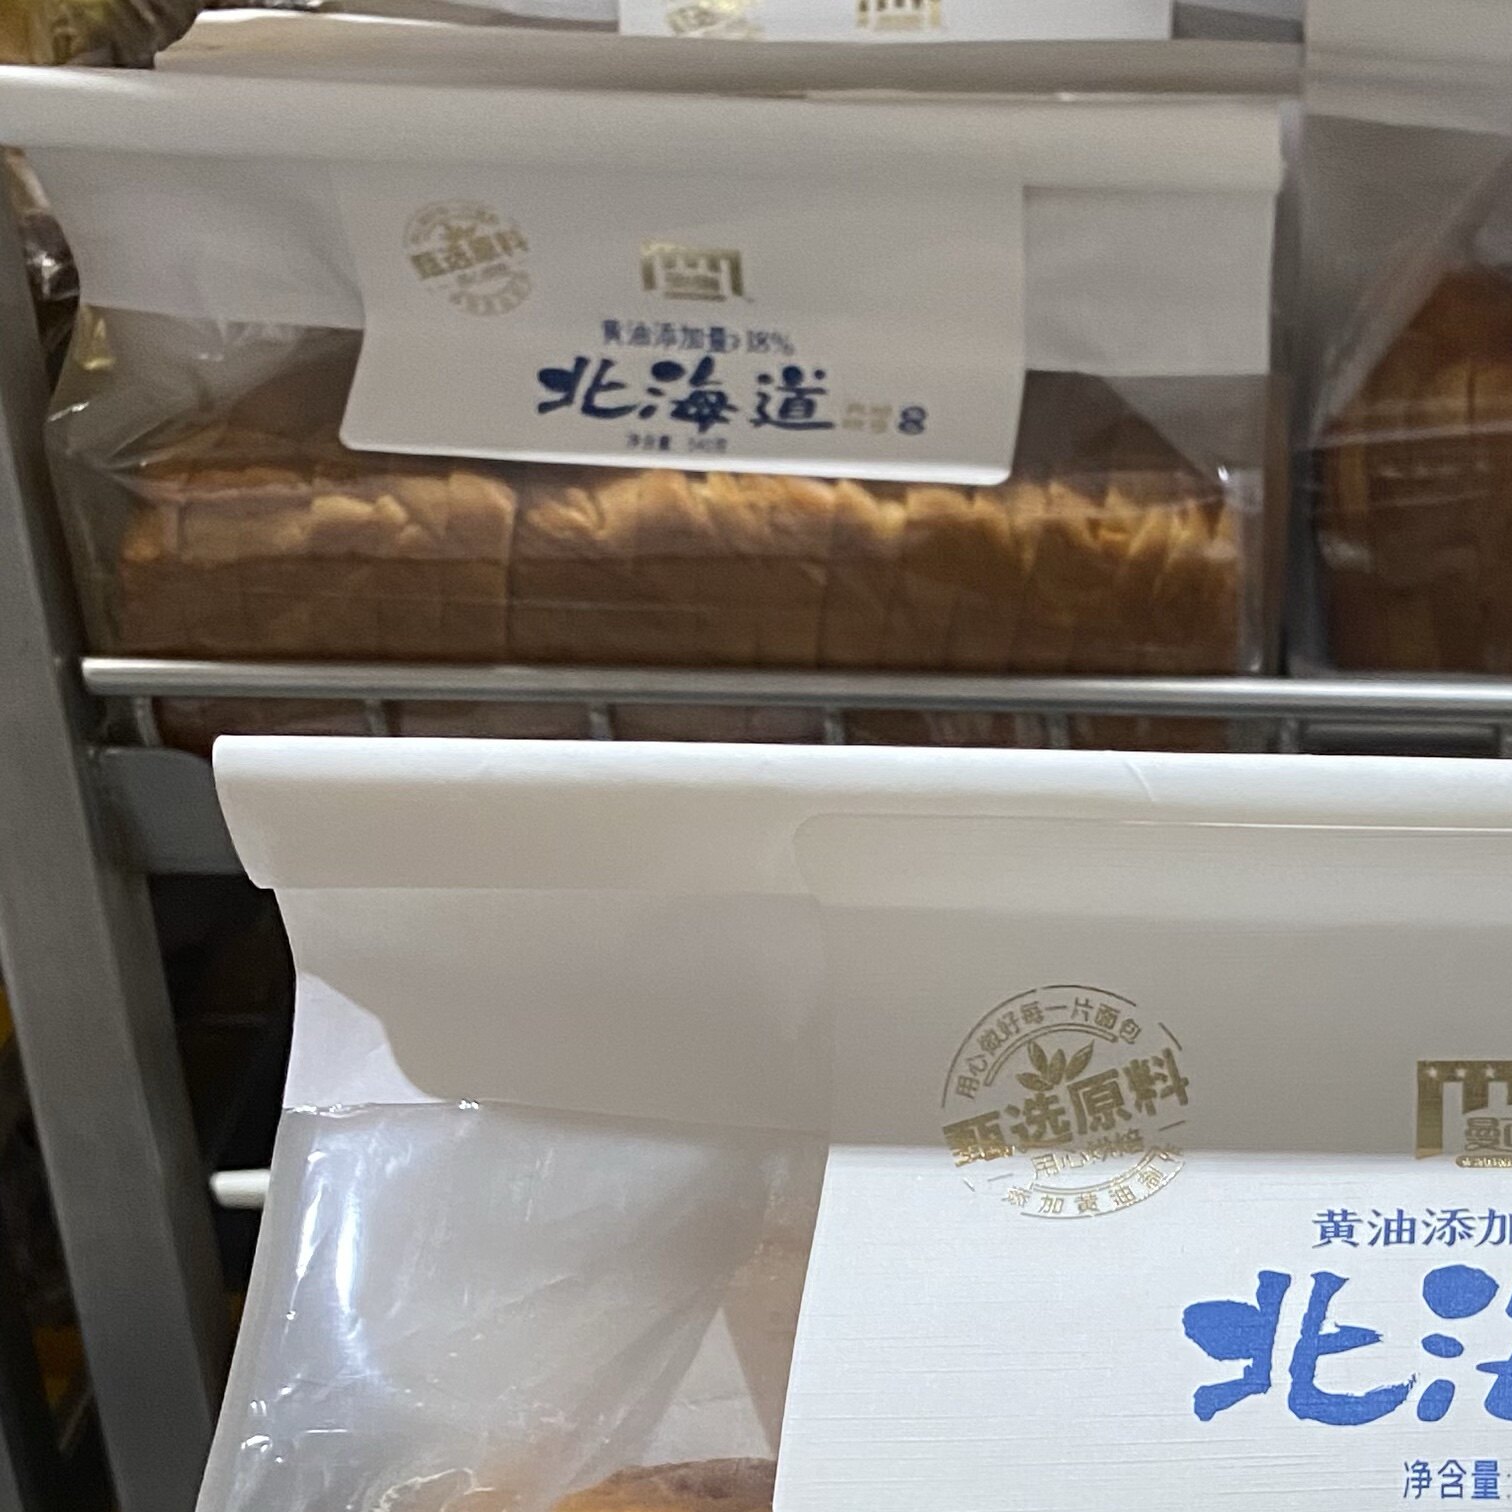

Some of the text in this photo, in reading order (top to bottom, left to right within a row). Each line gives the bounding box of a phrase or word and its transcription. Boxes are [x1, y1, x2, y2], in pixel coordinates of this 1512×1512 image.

[537, 356, 836, 434] 北海道
[942, 1047, 1190, 1168] 甄选原料
